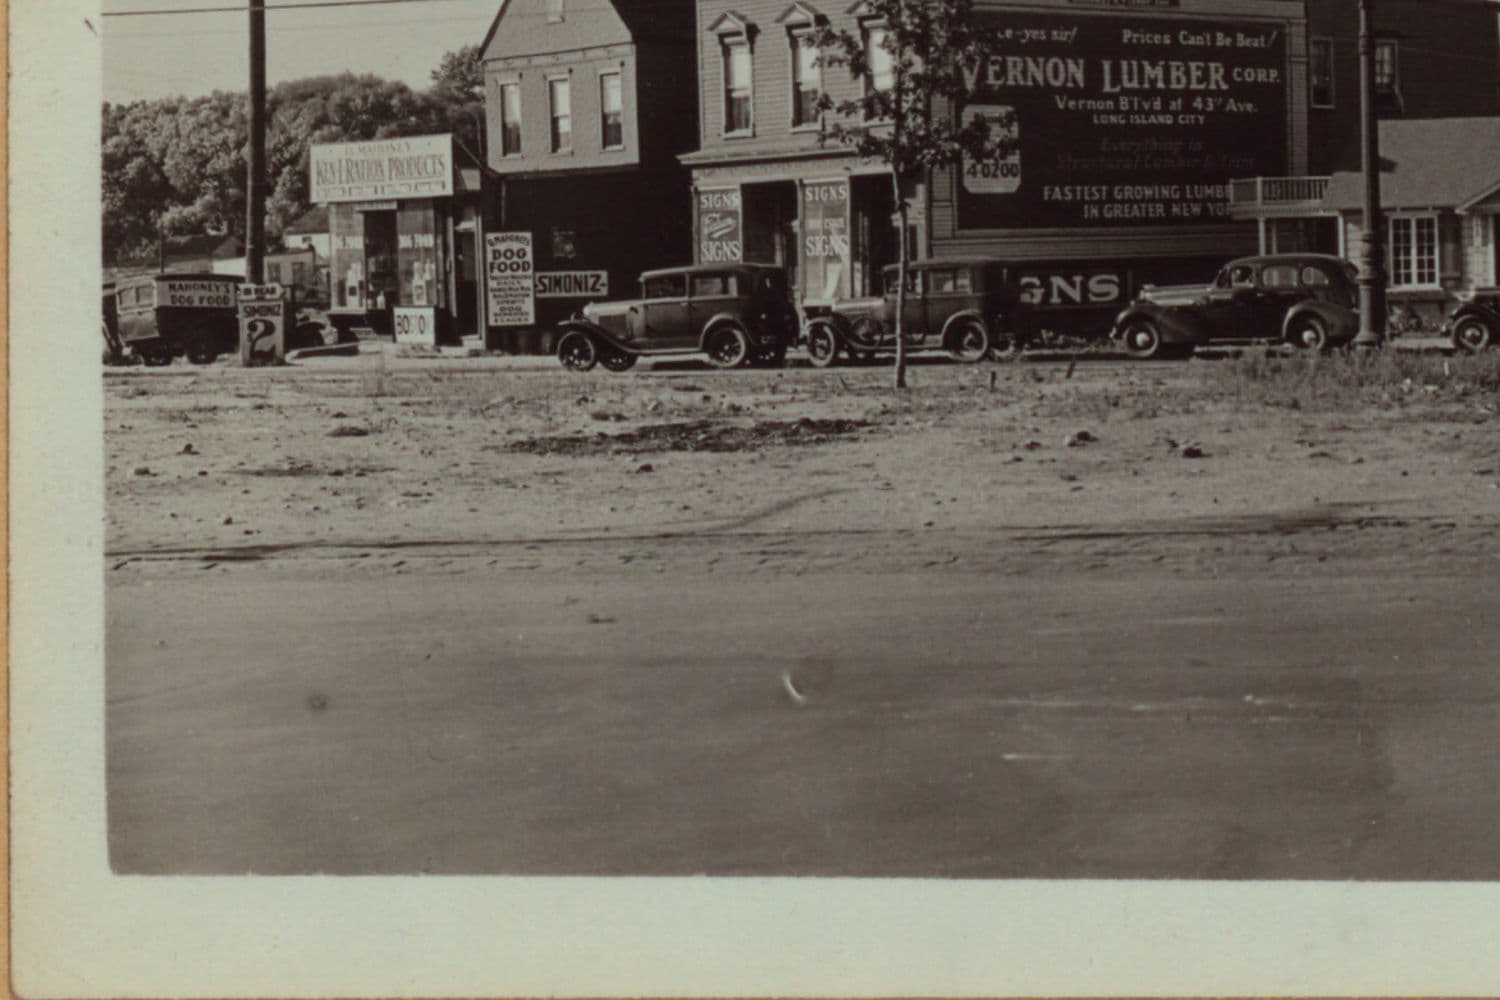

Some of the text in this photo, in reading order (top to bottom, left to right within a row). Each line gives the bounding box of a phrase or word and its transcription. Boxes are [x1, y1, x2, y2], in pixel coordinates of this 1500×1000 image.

[1122, 29, 1171, 45] Prices
[1178, 29, 1211, 46] Can't
[1215, 32, 1232, 47] Be
[958, 55, 1281, 93] VERNON LUMBER CORP.
[1055, 95, 1115, 110] Vernon
[1093, 114, 1207, 125] LONG ISLAND CITY
[700, 192, 741, 209] SIGNS
[805, 184, 848, 201] SIGNS
[1043, 186, 1108, 201] FASTEST
[1113, 185, 1180, 200] GROWING
[1084, 203, 1099, 219] IN
[1103, 202, 1166, 218] GREATER
[1172, 202, 1202, 217] NEW
[492, 248, 527, 260] DOG
[700, 240, 742, 262] SIGNS
[806, 234, 850, 257] SIGNS
[489, 261, 531, 273] FOOD
[537, 274, 602, 294] SIMONIZ
[170, 295, 231, 305] DOG FOOD
